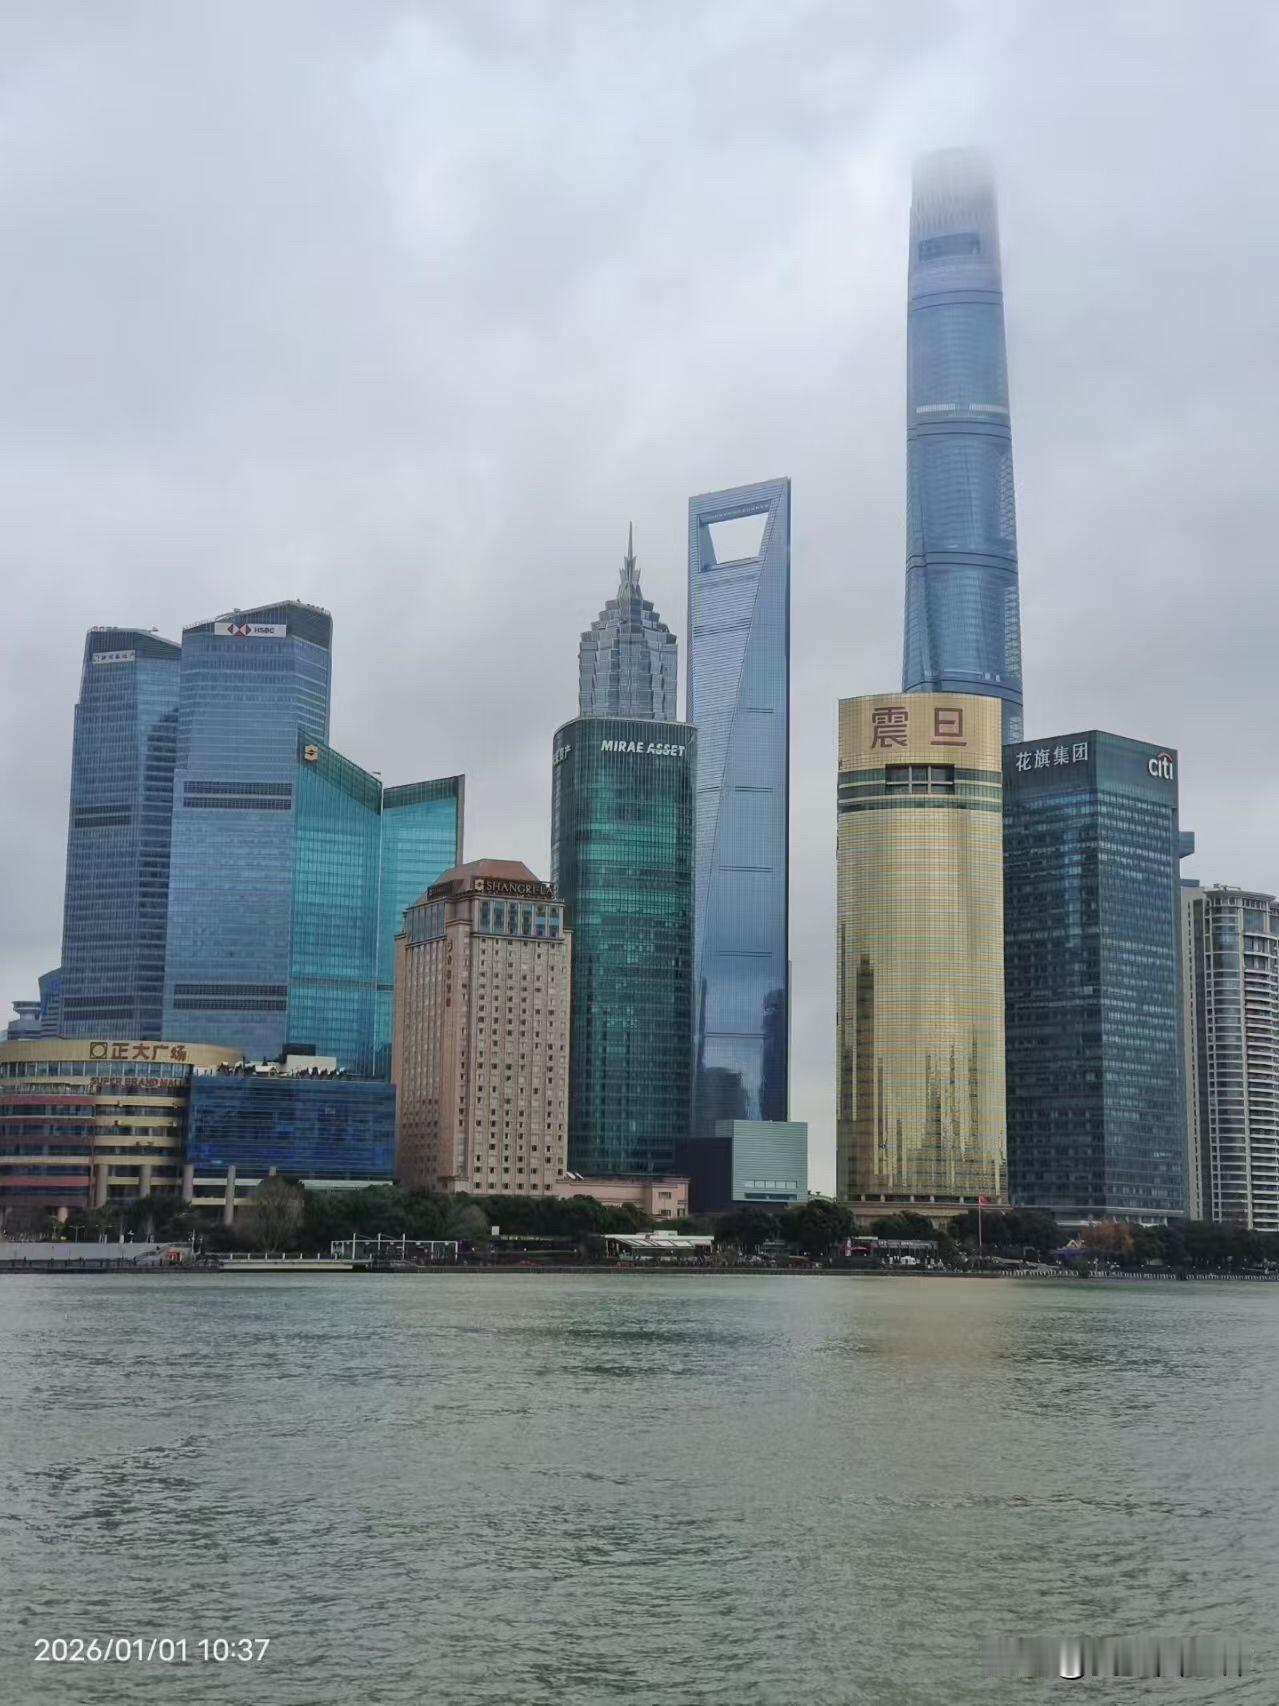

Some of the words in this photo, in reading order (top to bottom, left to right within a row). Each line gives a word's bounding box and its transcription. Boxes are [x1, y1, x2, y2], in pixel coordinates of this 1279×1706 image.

[254, 622, 275, 634] HSBC
[872, 706, 967, 748] 震旦
[600, 740, 643, 753] MIRAE
[646, 743, 685, 756] ASSET
[1015, 742, 1089, 772] 花旗集团
[1148, 754, 1174, 780] citi
[110, 1043, 187, 1061] 正大广场
